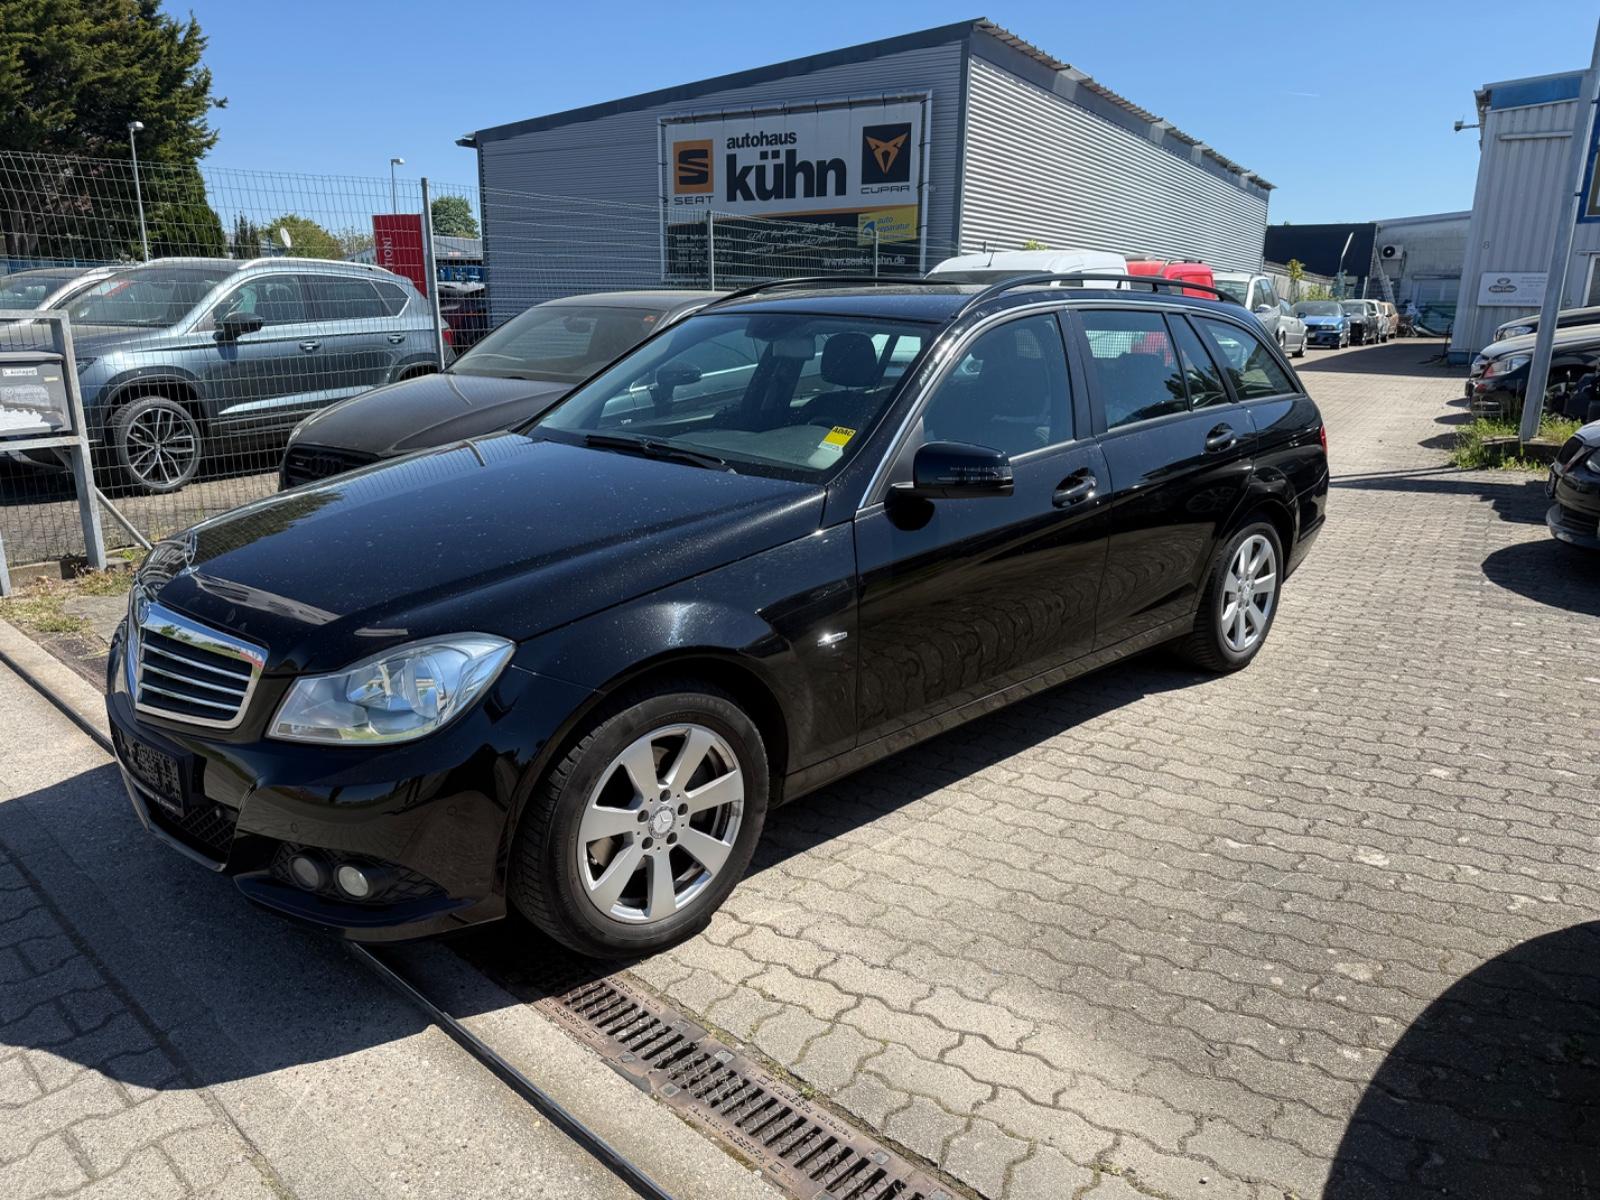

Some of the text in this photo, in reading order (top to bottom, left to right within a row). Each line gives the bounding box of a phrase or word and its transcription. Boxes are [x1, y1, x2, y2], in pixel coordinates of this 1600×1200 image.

[726, 131, 797, 149] autohaus
[726, 149, 847, 202] kühn
[860, 185, 910, 195] CUPRA
[673, 195, 714, 205] SEAT
